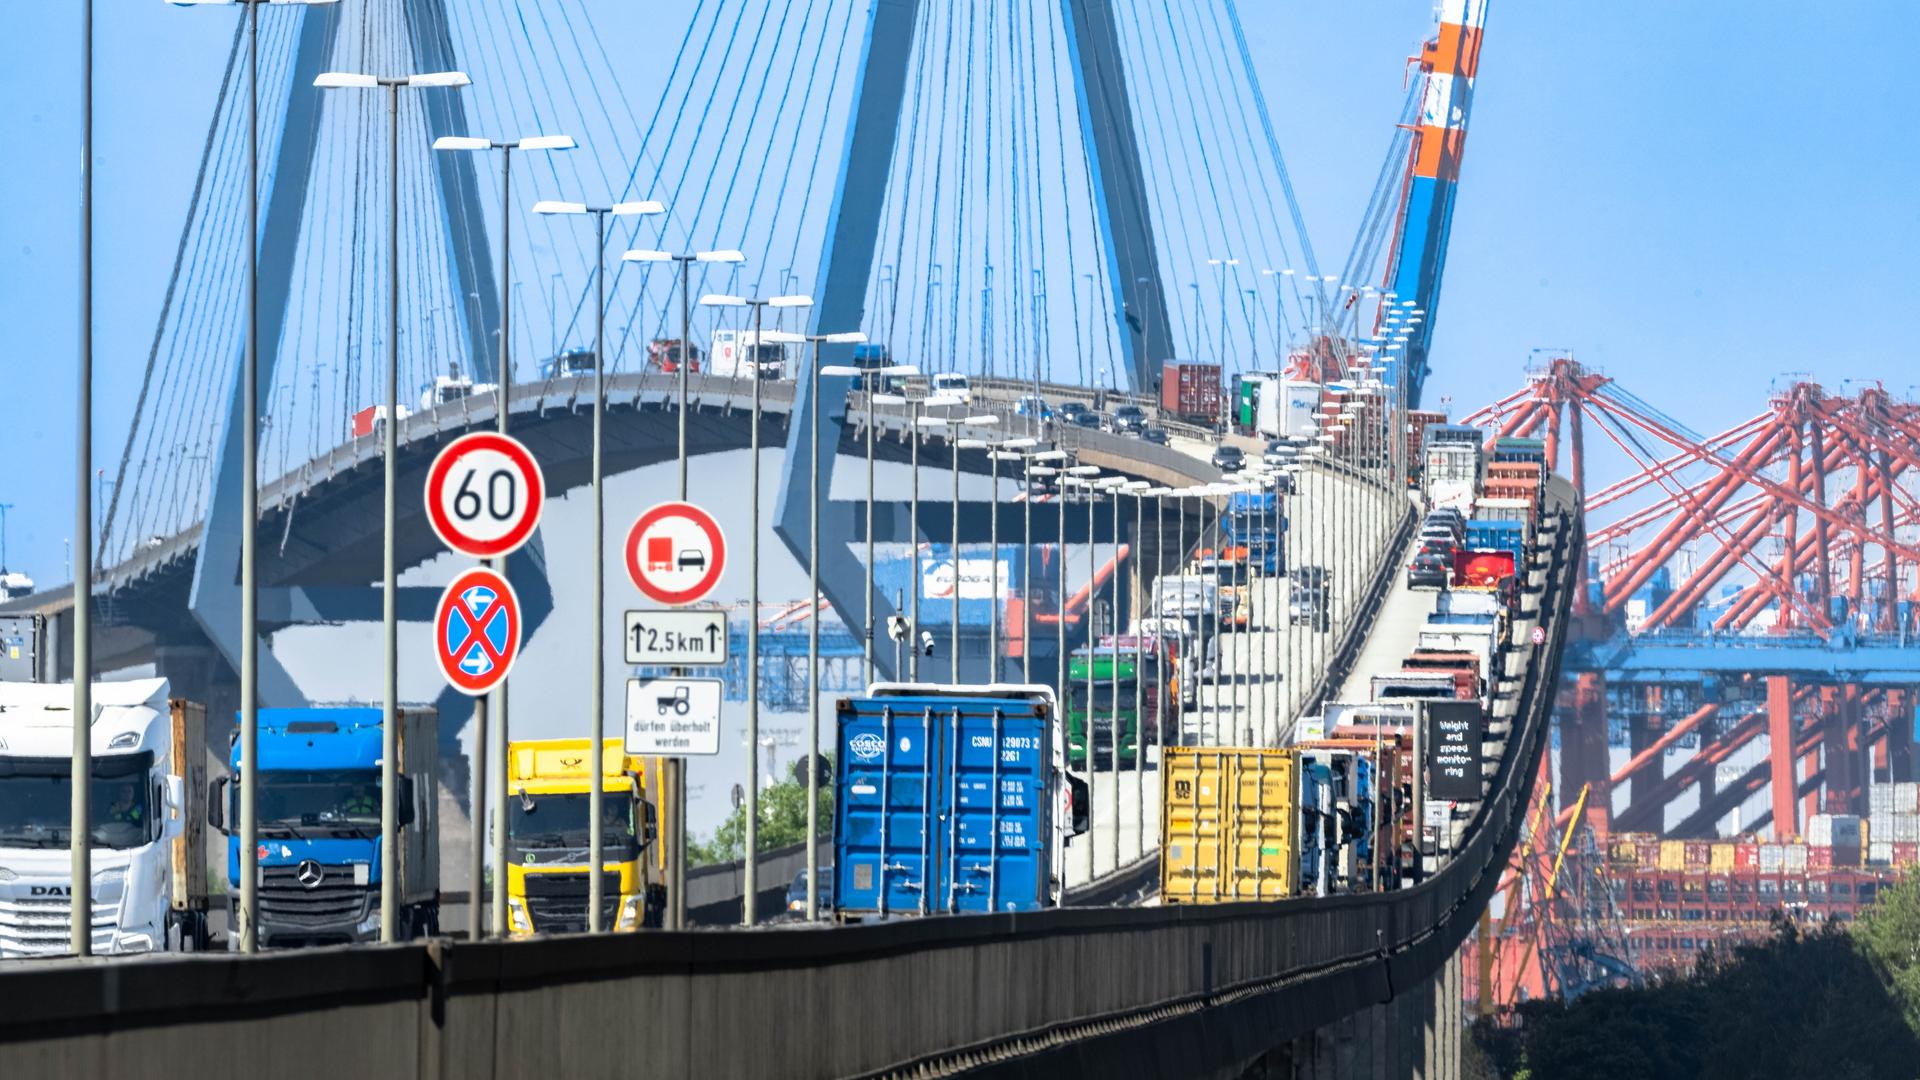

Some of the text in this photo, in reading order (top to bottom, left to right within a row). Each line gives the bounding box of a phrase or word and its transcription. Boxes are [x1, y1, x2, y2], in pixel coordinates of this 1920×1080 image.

[454, 468, 515, 521] 60
[633, 720, 711, 732] dürfen überholt
[655, 735, 690, 747] werden
